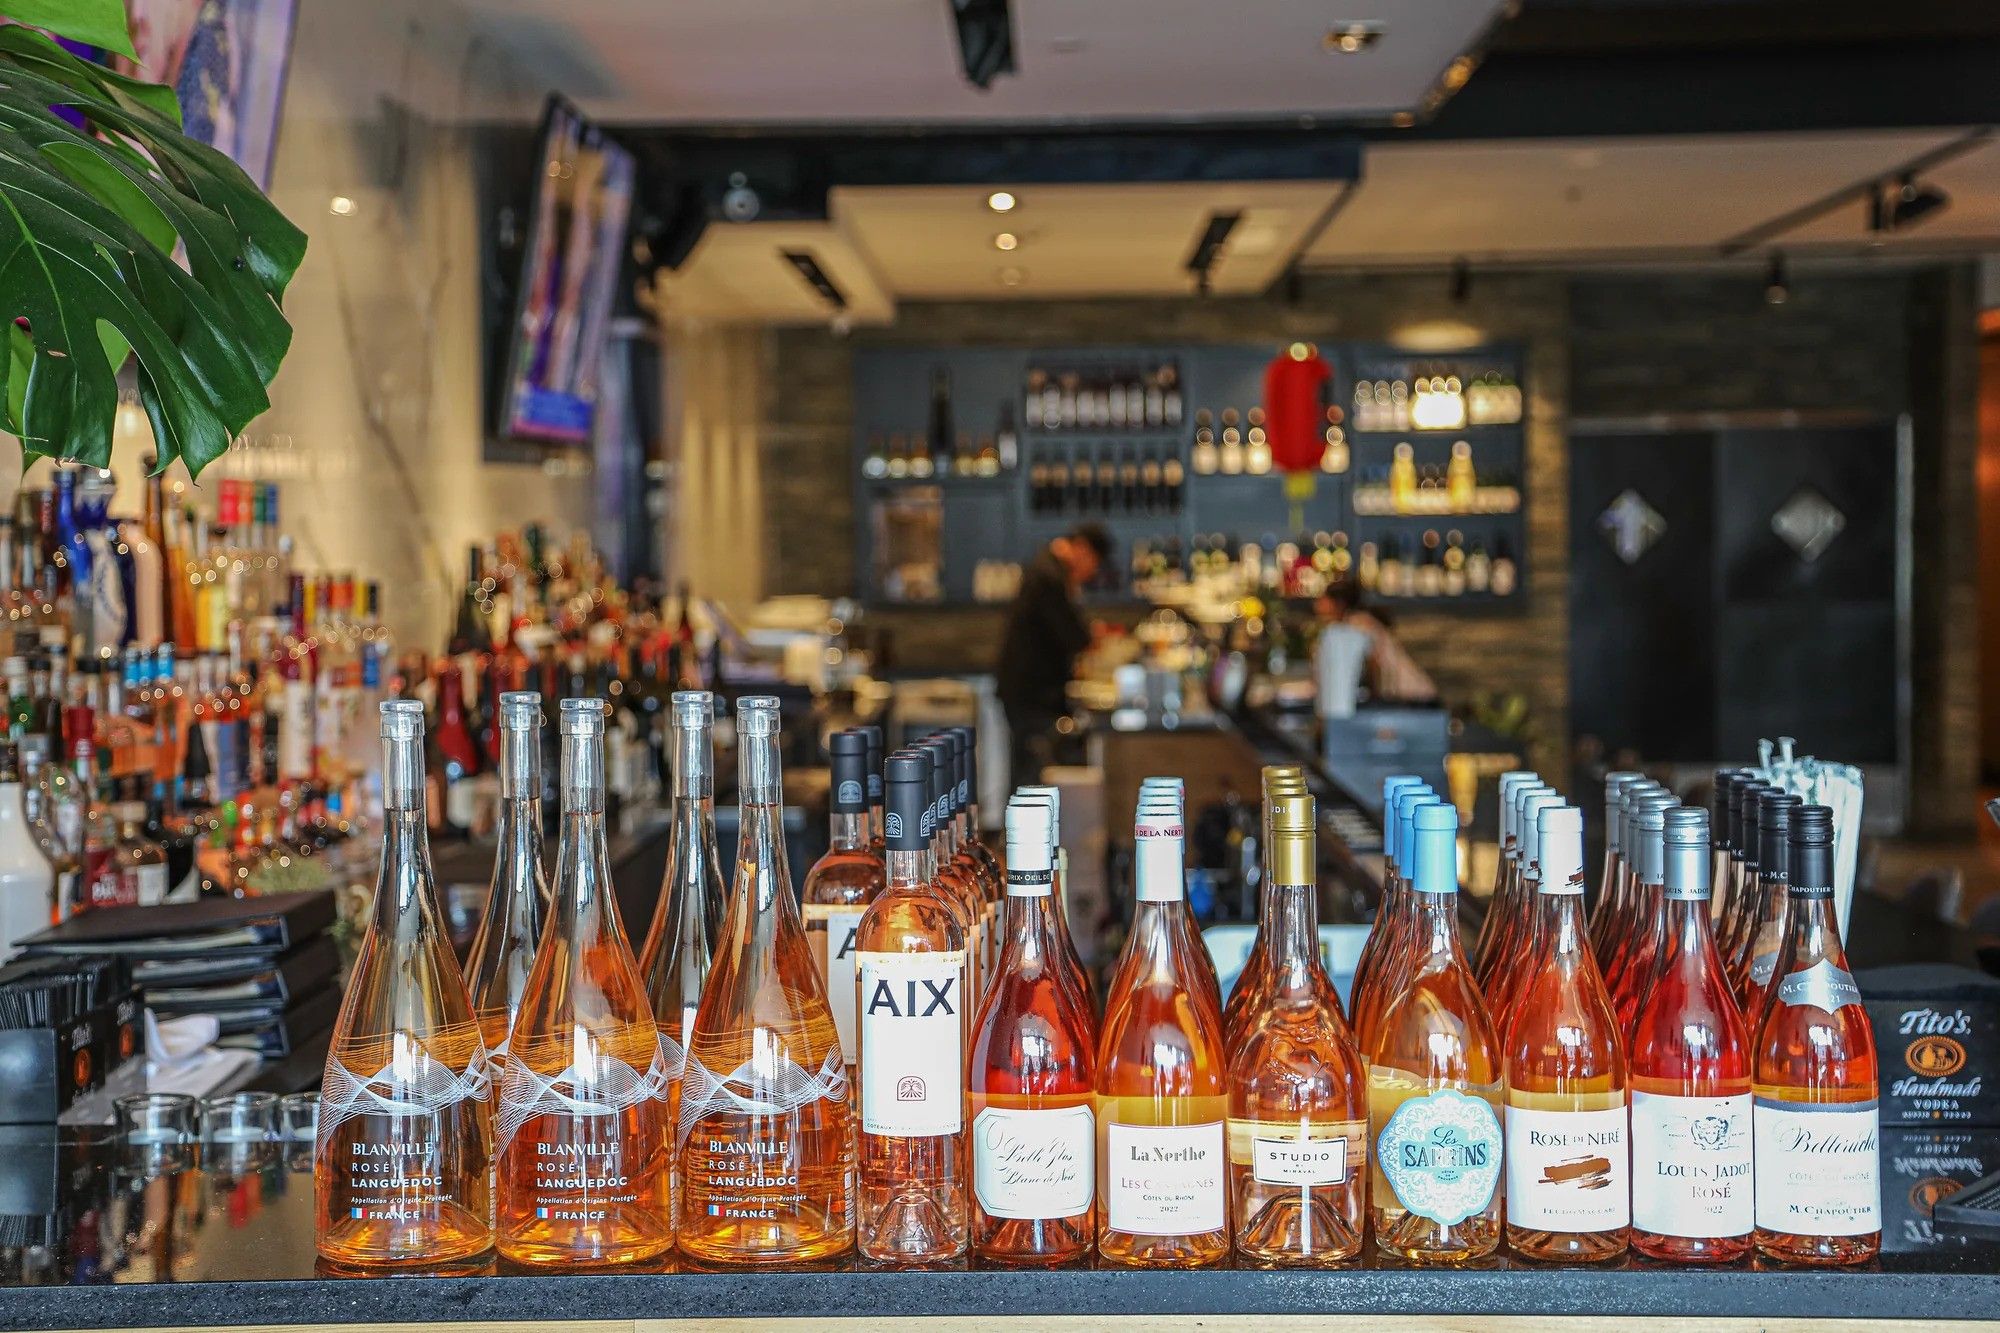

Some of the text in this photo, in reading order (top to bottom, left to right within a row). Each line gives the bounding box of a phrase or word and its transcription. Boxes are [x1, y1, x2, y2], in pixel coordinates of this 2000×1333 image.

[867, 977, 956, 1017] AIX
[1899, 1008, 1971, 1035] Tito's
[1890, 1076, 1982, 1097] Handmade
[1432, 1126, 1459, 1149] Les
[1588, 1128, 1620, 1146] NERÉ
[352, 1142, 435, 1156] BLANVILLE
[537, 1141, 620, 1156] BLANVILLE
[709, 1140, 789, 1154] BLANVILLE
[1131, 1145, 1206, 1162] La Nerthe
[1270, 1152, 1330, 1162] STUDIO
[351, 1161, 390, 1173] ROSÉ
[537, 1161, 575, 1173] ROSÉ
[708, 1159, 745, 1171] ROSÉ
[1658, 1161, 1750, 1181] LOUIS JADOT
[351, 1176, 442, 1188] LANGUEDOC
[537, 1176, 628, 1188] LANGUEDOC
[708, 1175, 797, 1187] LANGUEDOC
[1121, 1177, 1141, 1190] LES
[1692, 1182, 1731, 1198] ROSÉ
[369, 1210, 420, 1220] FRANCE
[555, 1210, 605, 1220] FRANCE
[725, 1209, 775, 1218] FRANCE
